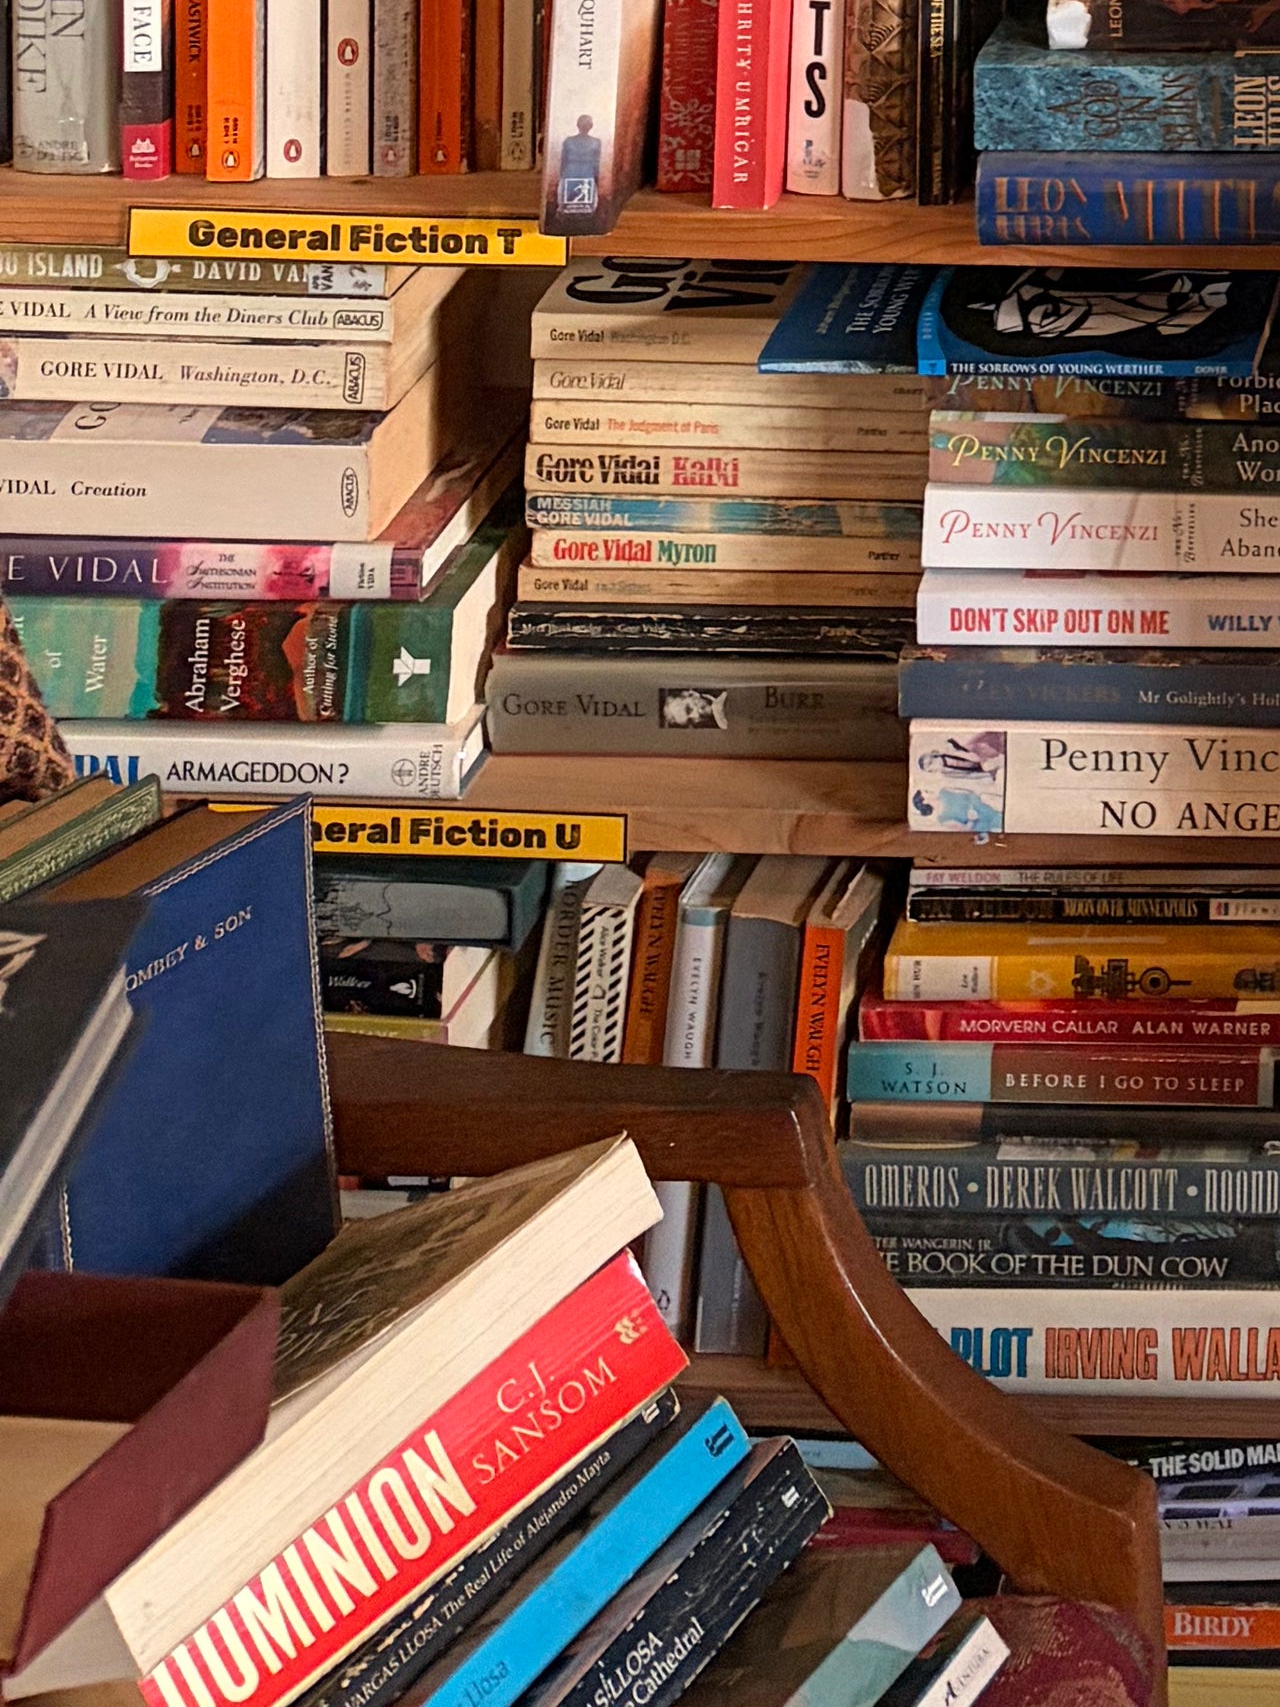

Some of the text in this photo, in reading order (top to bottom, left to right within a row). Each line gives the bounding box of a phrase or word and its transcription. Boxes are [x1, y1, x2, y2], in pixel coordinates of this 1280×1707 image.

[189, 220, 523, 256] General Fiction T
[949, 605, 1101, 634] DON'T SKIP OUT
[166, 759, 349, 787] ARMAGEDDON?
[1101, 800, 1159, 830] NO
[409, 818, 581, 849] Fiction U
[864, 1165, 1179, 1213] OMEROS DEREK WALCOTT
[473, 1357, 617, 1485] SANSOM
